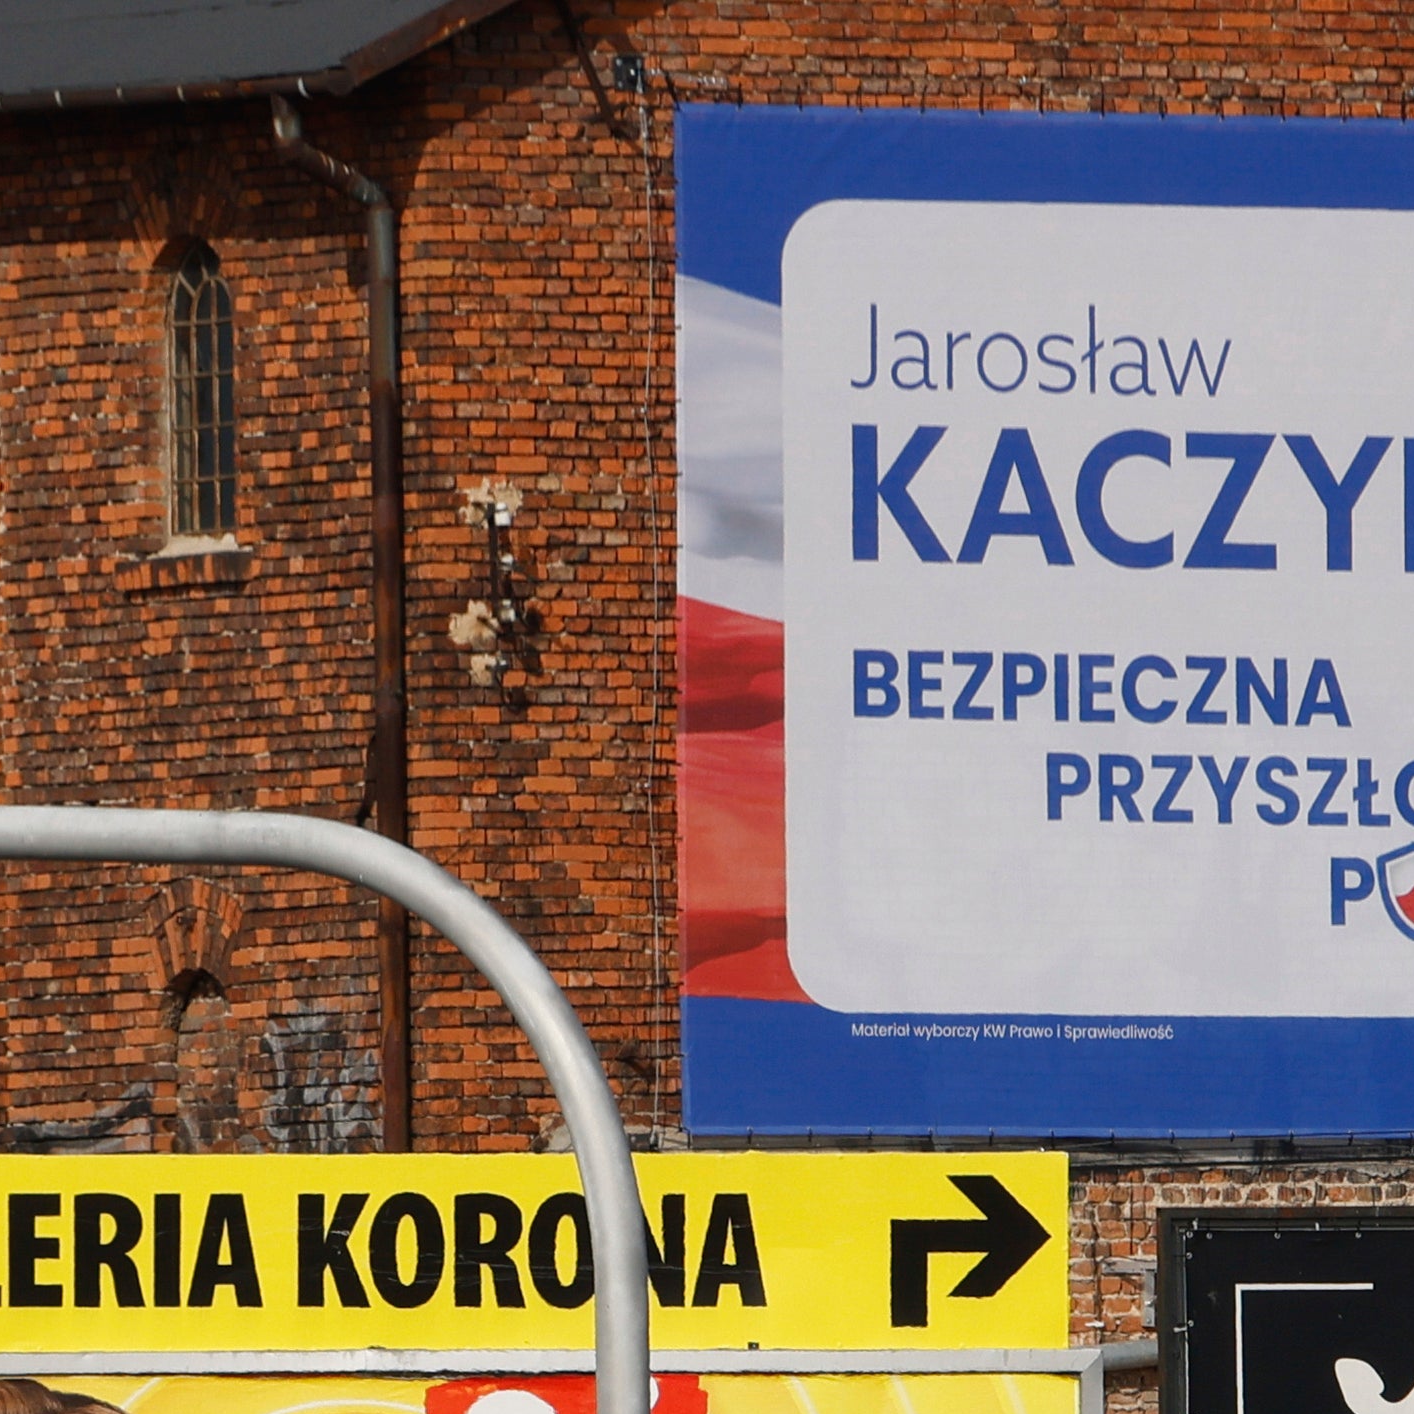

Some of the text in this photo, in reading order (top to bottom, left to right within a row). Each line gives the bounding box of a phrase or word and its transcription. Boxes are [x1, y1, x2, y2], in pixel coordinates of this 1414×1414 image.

[850, 303, 1232, 397] Jarosław
[853, 649, 1351, 727] BEZPIECZNA
[851, 1022, 911, 1038] Materiał
[913, 1023, 980, 1041] wyborczy
[983, 1024, 1007, 1038] KW
[1009, 1024, 1054, 1039] Prawo
[1064, 1024, 1175, 1042] Sprawiedliwość
[297, 1192, 768, 1310] KORONA
